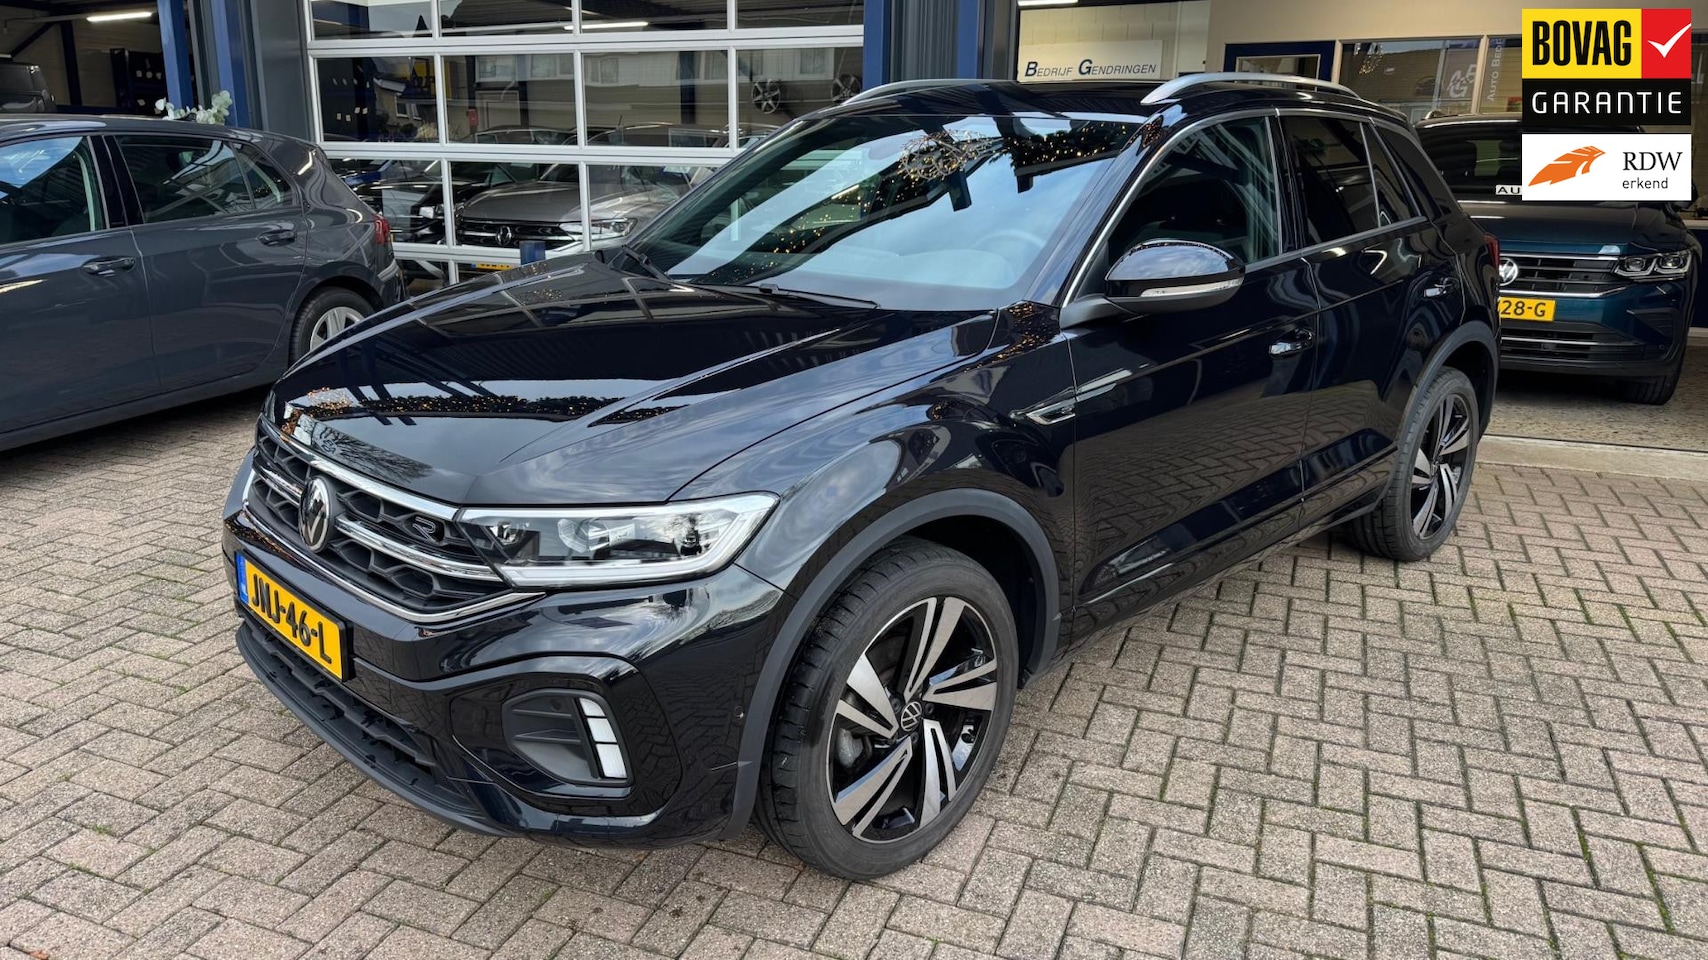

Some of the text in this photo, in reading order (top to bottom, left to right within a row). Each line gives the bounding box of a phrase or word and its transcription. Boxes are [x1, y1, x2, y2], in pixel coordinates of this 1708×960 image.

[1024, 59, 1157, 77] BEDRIJF GENDRINGEN
[251, 573, 333, 665] JNJ-46-L
